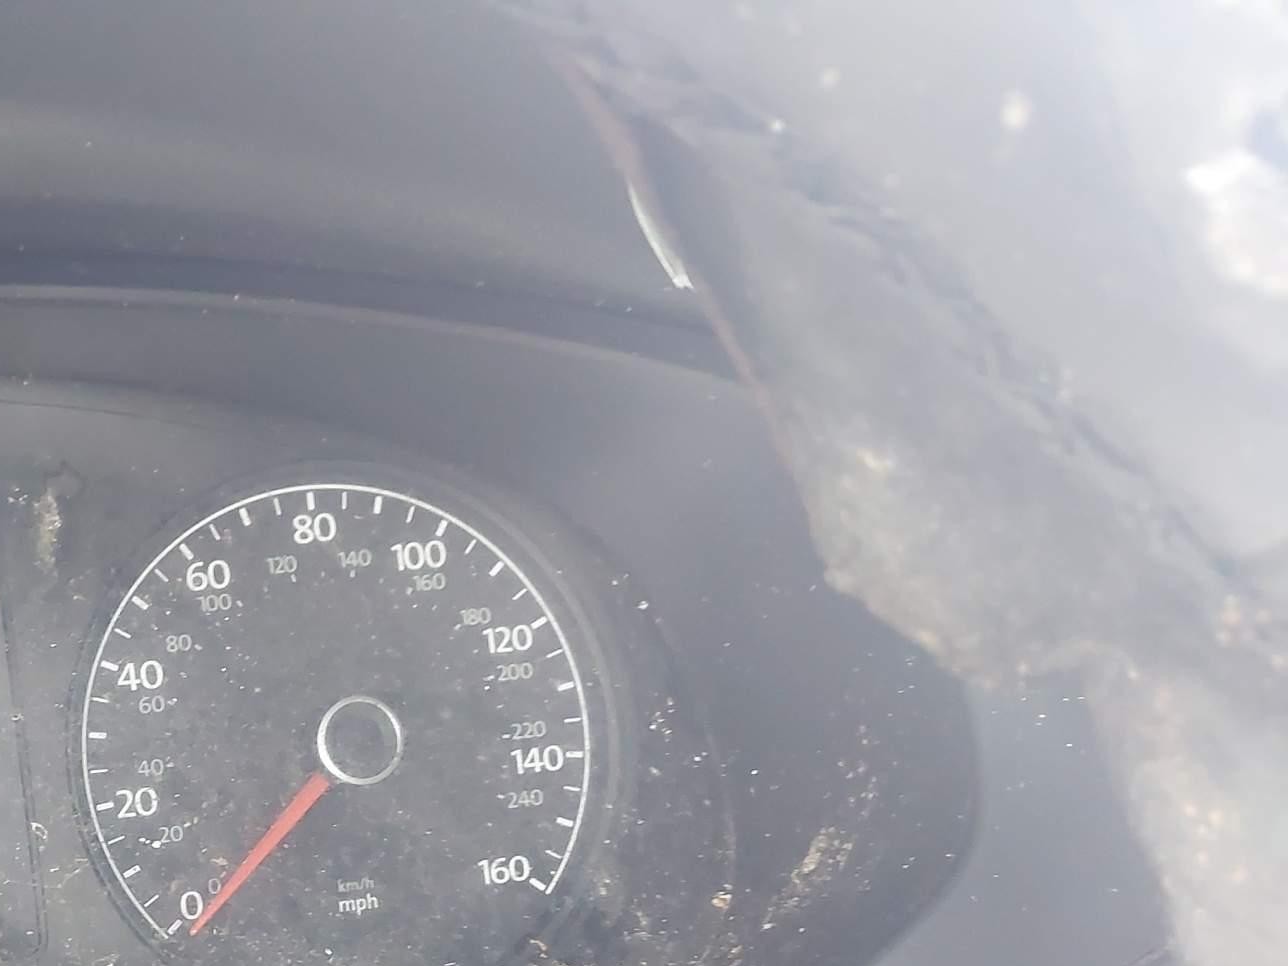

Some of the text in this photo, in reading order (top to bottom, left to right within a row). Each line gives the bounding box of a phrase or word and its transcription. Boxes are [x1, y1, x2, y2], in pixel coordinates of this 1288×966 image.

[293, 512, 337, 544] 80
[337, 549, 372, 568] 140
[391, 539, 447, 571] 100
[266, 555, 297, 575] 120
[185, 561, 231, 591] 60
[413, 573, 446, 591] 160
[198, 594, 232, 612] 100
[460, 607, 491, 625] 180
[166, 634, 192, 652] 80
[482, 625, 533, 655] 120
[117, 660, 164, 691] 40
[497, 662, 533, 681] 200
[139, 695, 165, 713] 60
[510, 720, 546, 739] 220
[138, 758, 164, 777] 40
[510, 744, 564, 772] 140
[115, 787, 158, 818] 20
[507, 788, 543, 808] 240
[159, 825, 184, 844] 20
[478, 855, 531, 884] 160
[337, 877, 375, 893] km/h
[179, 891, 203, 920] 0
[338, 894, 379, 913] mph
